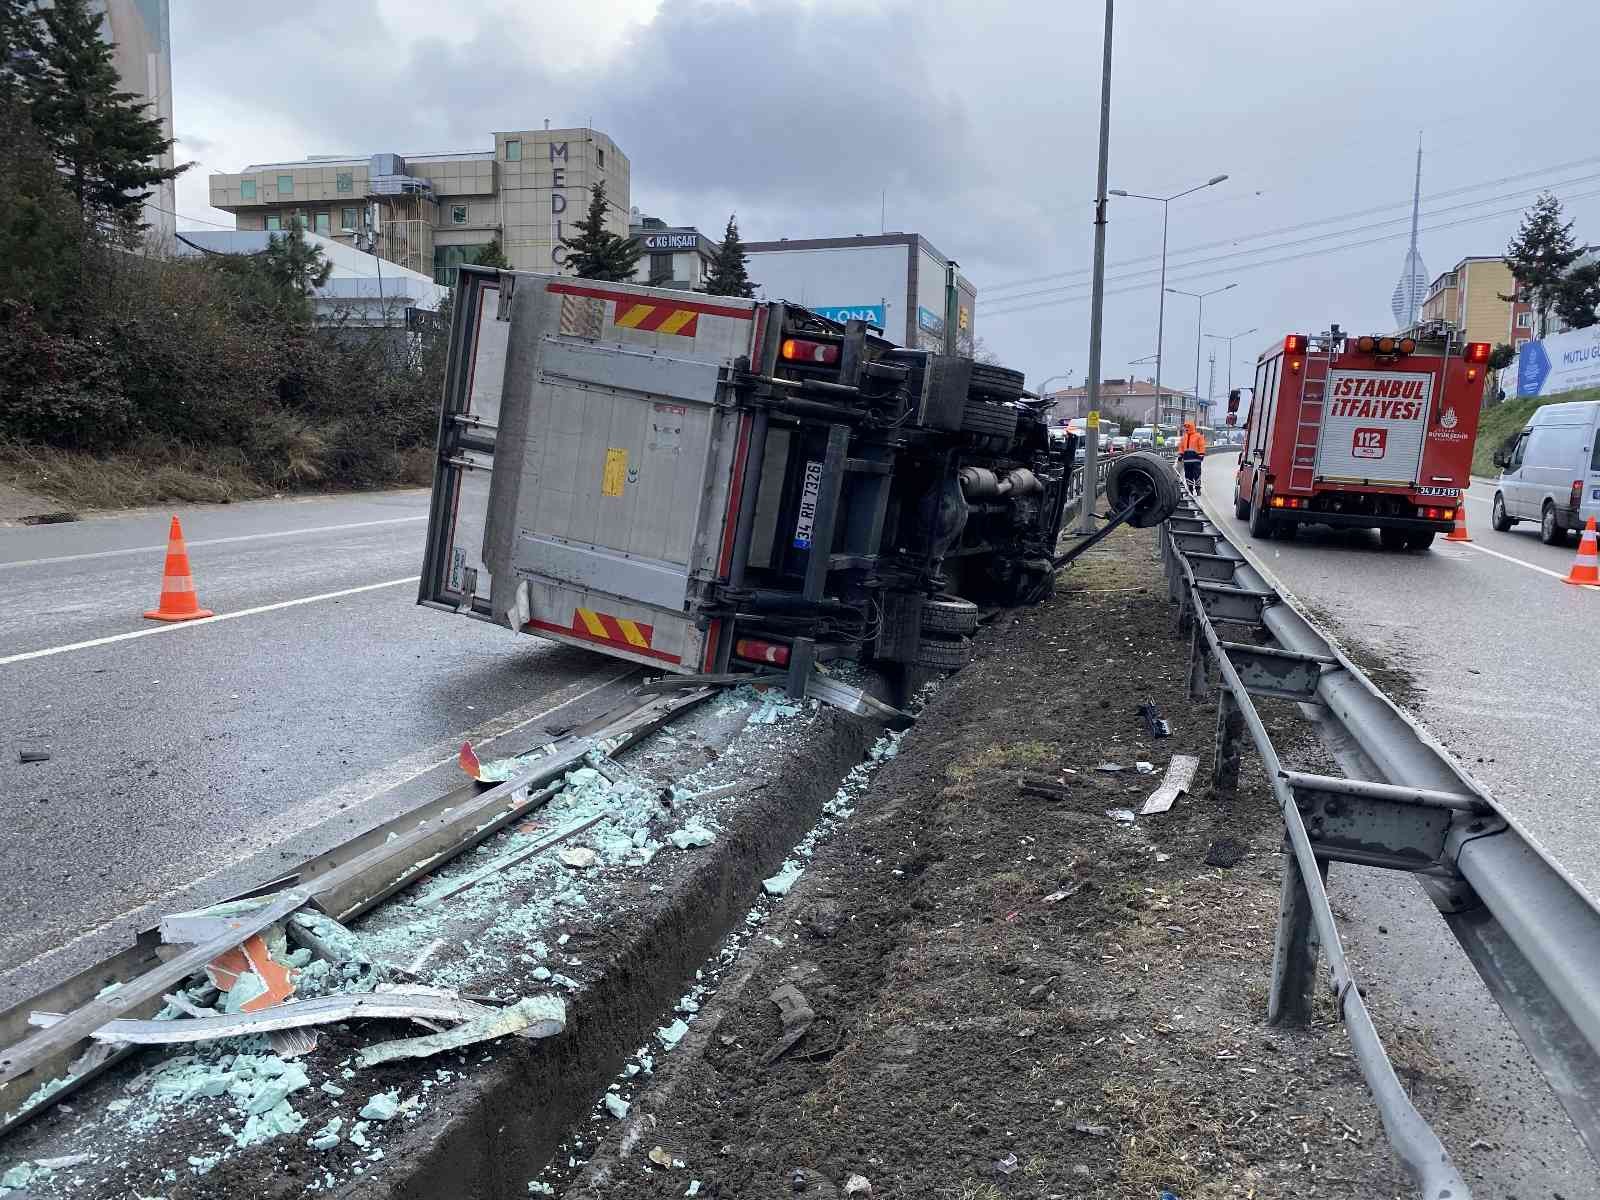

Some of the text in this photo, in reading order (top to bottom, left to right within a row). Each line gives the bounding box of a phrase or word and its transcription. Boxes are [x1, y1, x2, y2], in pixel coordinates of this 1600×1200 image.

[550, 142, 569, 270] MEDIC
[656, 235, 697, 249] KG İNŞAAT
[824, 309, 878, 323] LONA
[1563, 348, 1590, 363] MUTLU
[1357, 431, 1381, 447] 112
[804, 464, 821, 497] 7326
[801, 502, 815, 519] RH
[798, 523, 812, 540] 34
